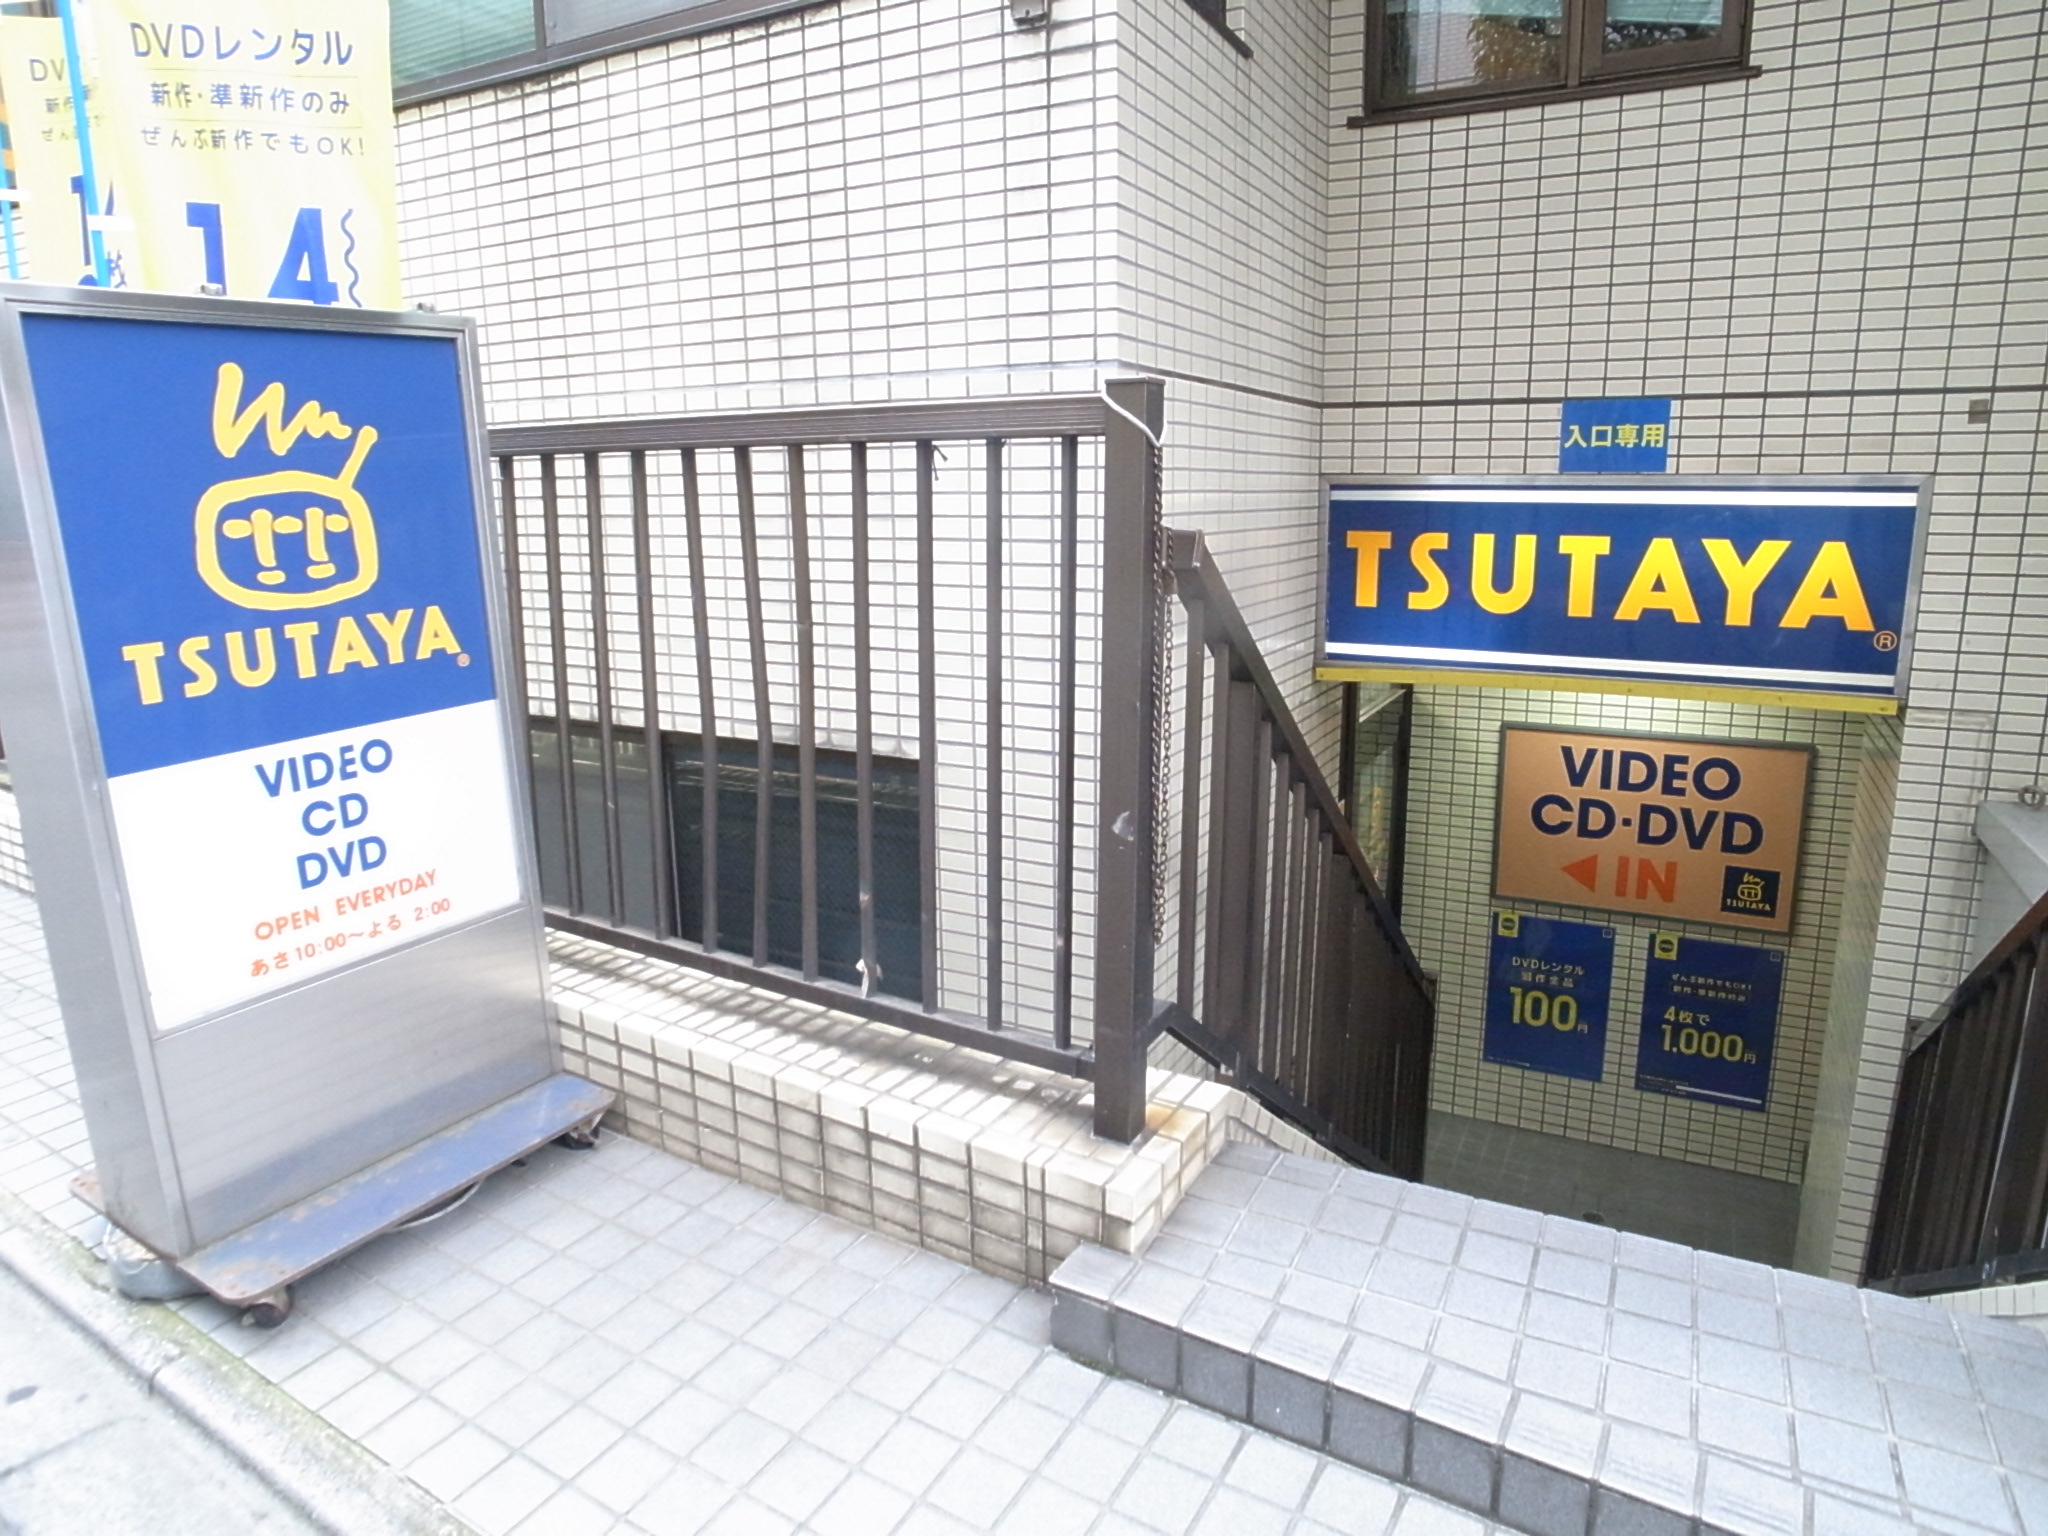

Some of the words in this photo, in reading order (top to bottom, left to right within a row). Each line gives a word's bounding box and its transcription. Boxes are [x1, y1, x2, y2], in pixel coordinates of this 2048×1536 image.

[130, 22, 353, 66] DVDレンタル
[150, 82, 350, 115] 新作・準新作のみ
[1564, 423, 1667, 449] 入口専用
[1346, 530, 1877, 632] TSUTAYA
[121, 605, 462, 705] TSUTAYA
[254, 738, 393, 798] VIDEO
[1560, 745, 1741, 801] VIDEO
[301, 792, 369, 836] CD
[295, 835, 387, 890] DVD
[1614, 855, 1678, 903] IN
[254, 905, 320, 941] OPEN
[335, 868, 437, 916] EVERYDAY
[1512, 956, 1585, 976] DVDレンタル
[1664, 1005, 1710, 1026] 4枚で
